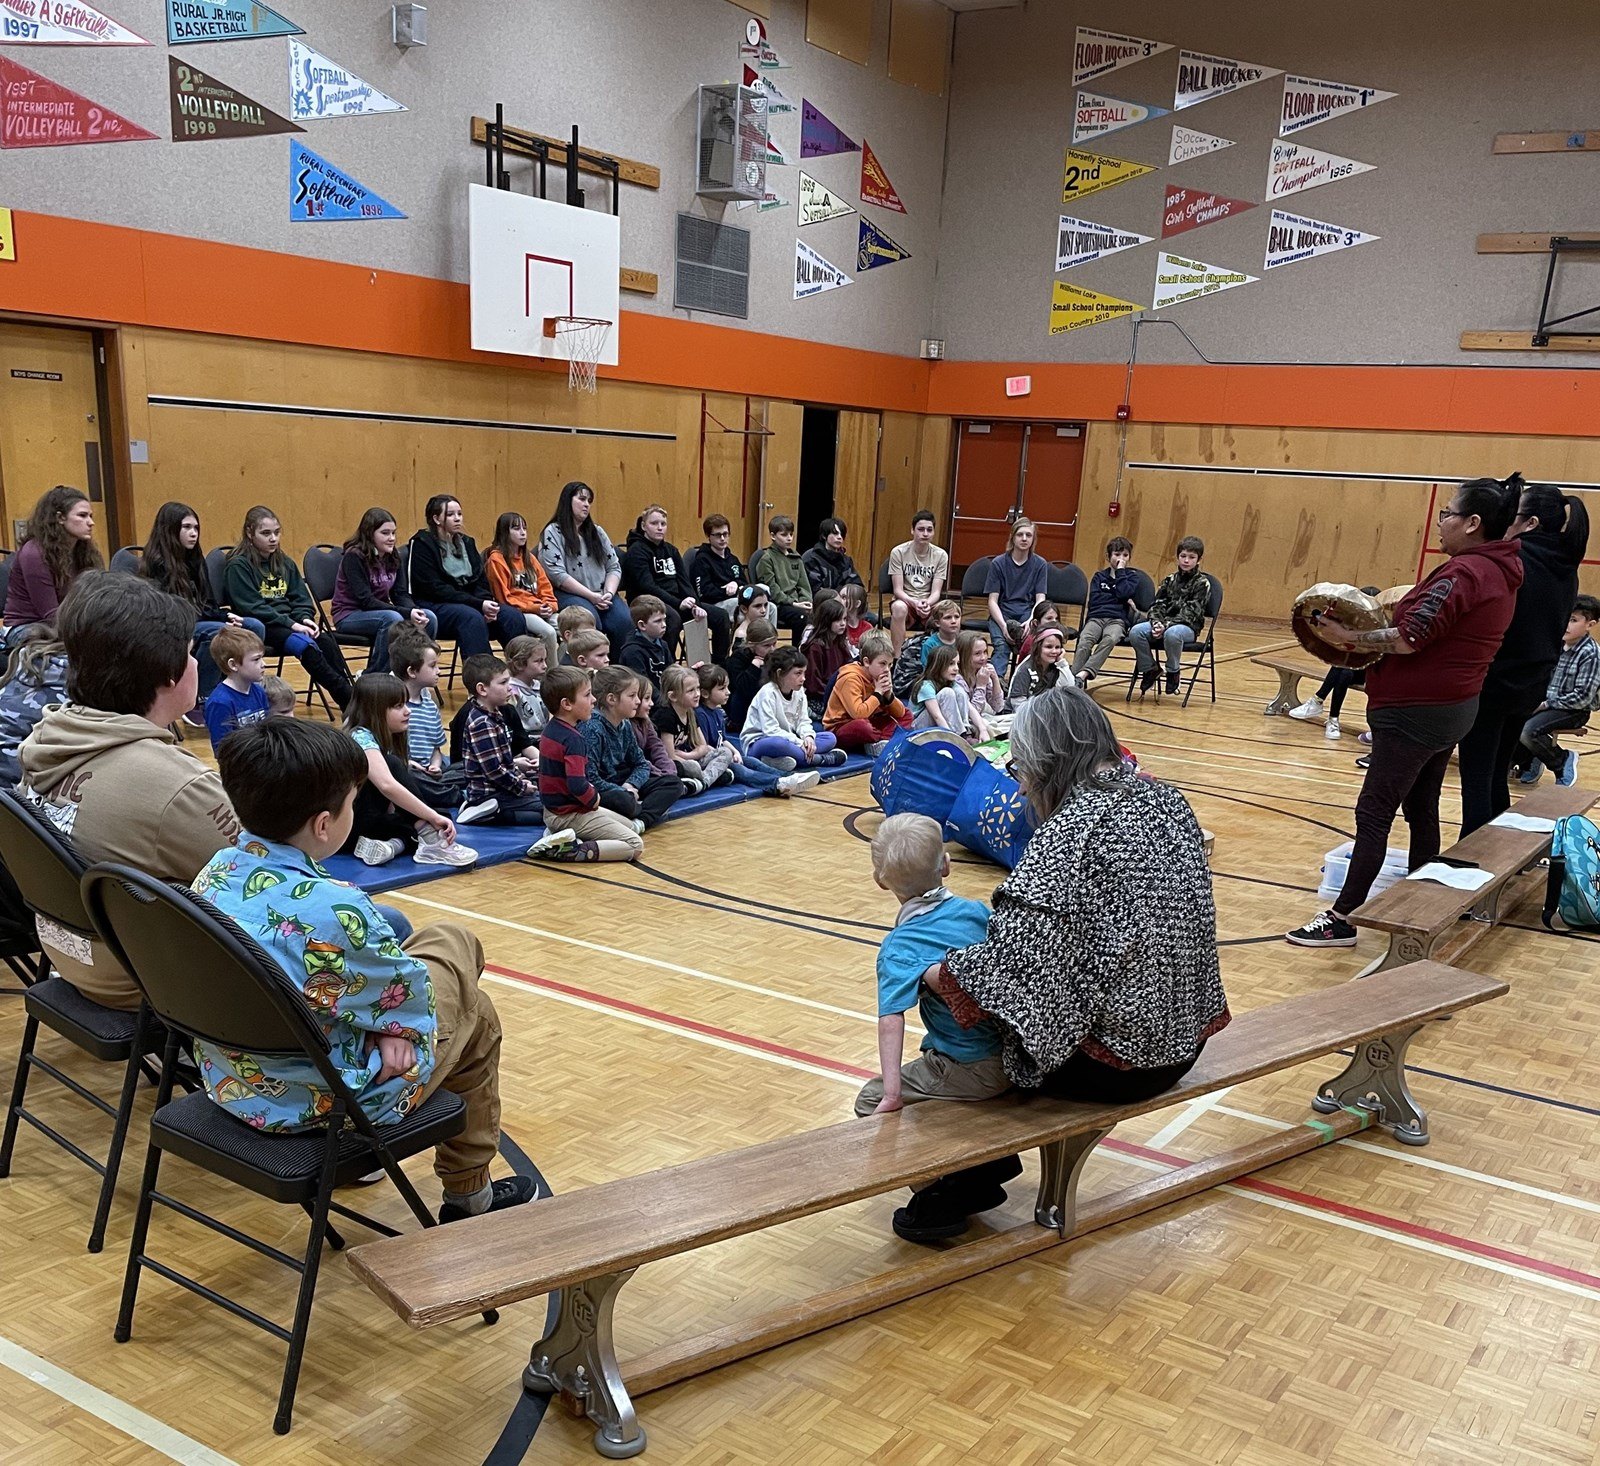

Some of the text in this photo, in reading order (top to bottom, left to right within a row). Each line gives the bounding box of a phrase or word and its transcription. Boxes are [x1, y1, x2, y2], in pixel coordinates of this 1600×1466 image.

[172, 2, 208, 19] RURAL
[4, 18, 39, 39] 1997
[54, 3, 109, 38] Softball
[174, 22, 248, 37] BASKETBALL
[1075, 42, 1158, 70] FLOOR HOCKEY 3rd
[1074, 61, 1117, 82] Tournament
[1178, 64, 1263, 94] BALL HOCKEY
[6, 80, 36, 97] 1997
[7, 101, 75, 116] INTERMEDIATE
[177, 93, 265, 126] VOLLEYBALL
[1283, 89, 1375, 120] FLOOR HOCKEY 1st
[1077, 108, 1127, 124] SOFTBALL
[1282, 110, 1330, 133] Tournament
[184, 120, 216, 135] 1998
[1068, 150, 1122, 169] Horsefly School
[1273, 145, 1298, 162] Boys
[299, 152, 367, 199] RURAL SECONDARY
[1064, 165, 1100, 191] 2nd
[1272, 160, 1353, 195] Champions 1986
[295, 168, 344, 212] Softball
[1166, 190, 1186, 208] 1985
[360, 204, 382, 217] 1998
[1165, 210, 1184, 226] Girls
[1196, 202, 1231, 223] CHAMPS
[1061, 216, 1114, 234] 2010 Rural Schools
[1118, 235, 1140, 248] SCHOOL
[1268, 226, 1361, 254] BALL HOCKEY 3rd
[1058, 251, 1100, 270] Tournament
[1166, 254, 1207, 272] Williams Lake
[1267, 248, 1314, 268] Tournament
[797, 256, 811, 284] BALL
[812, 264, 835, 283] HOCKEY
[1158, 273, 1247, 285] Small School Champions
[1059, 283, 1097, 299] Williams Lake
[1157, 296, 1175, 306] Cross
[1176, 287, 1203, 301] Country
[1052, 302, 1133, 313] Small School Champions
[1051, 312, 1110, 334] Cross Country 2010
[13, 370, 26, 378] BOYS
